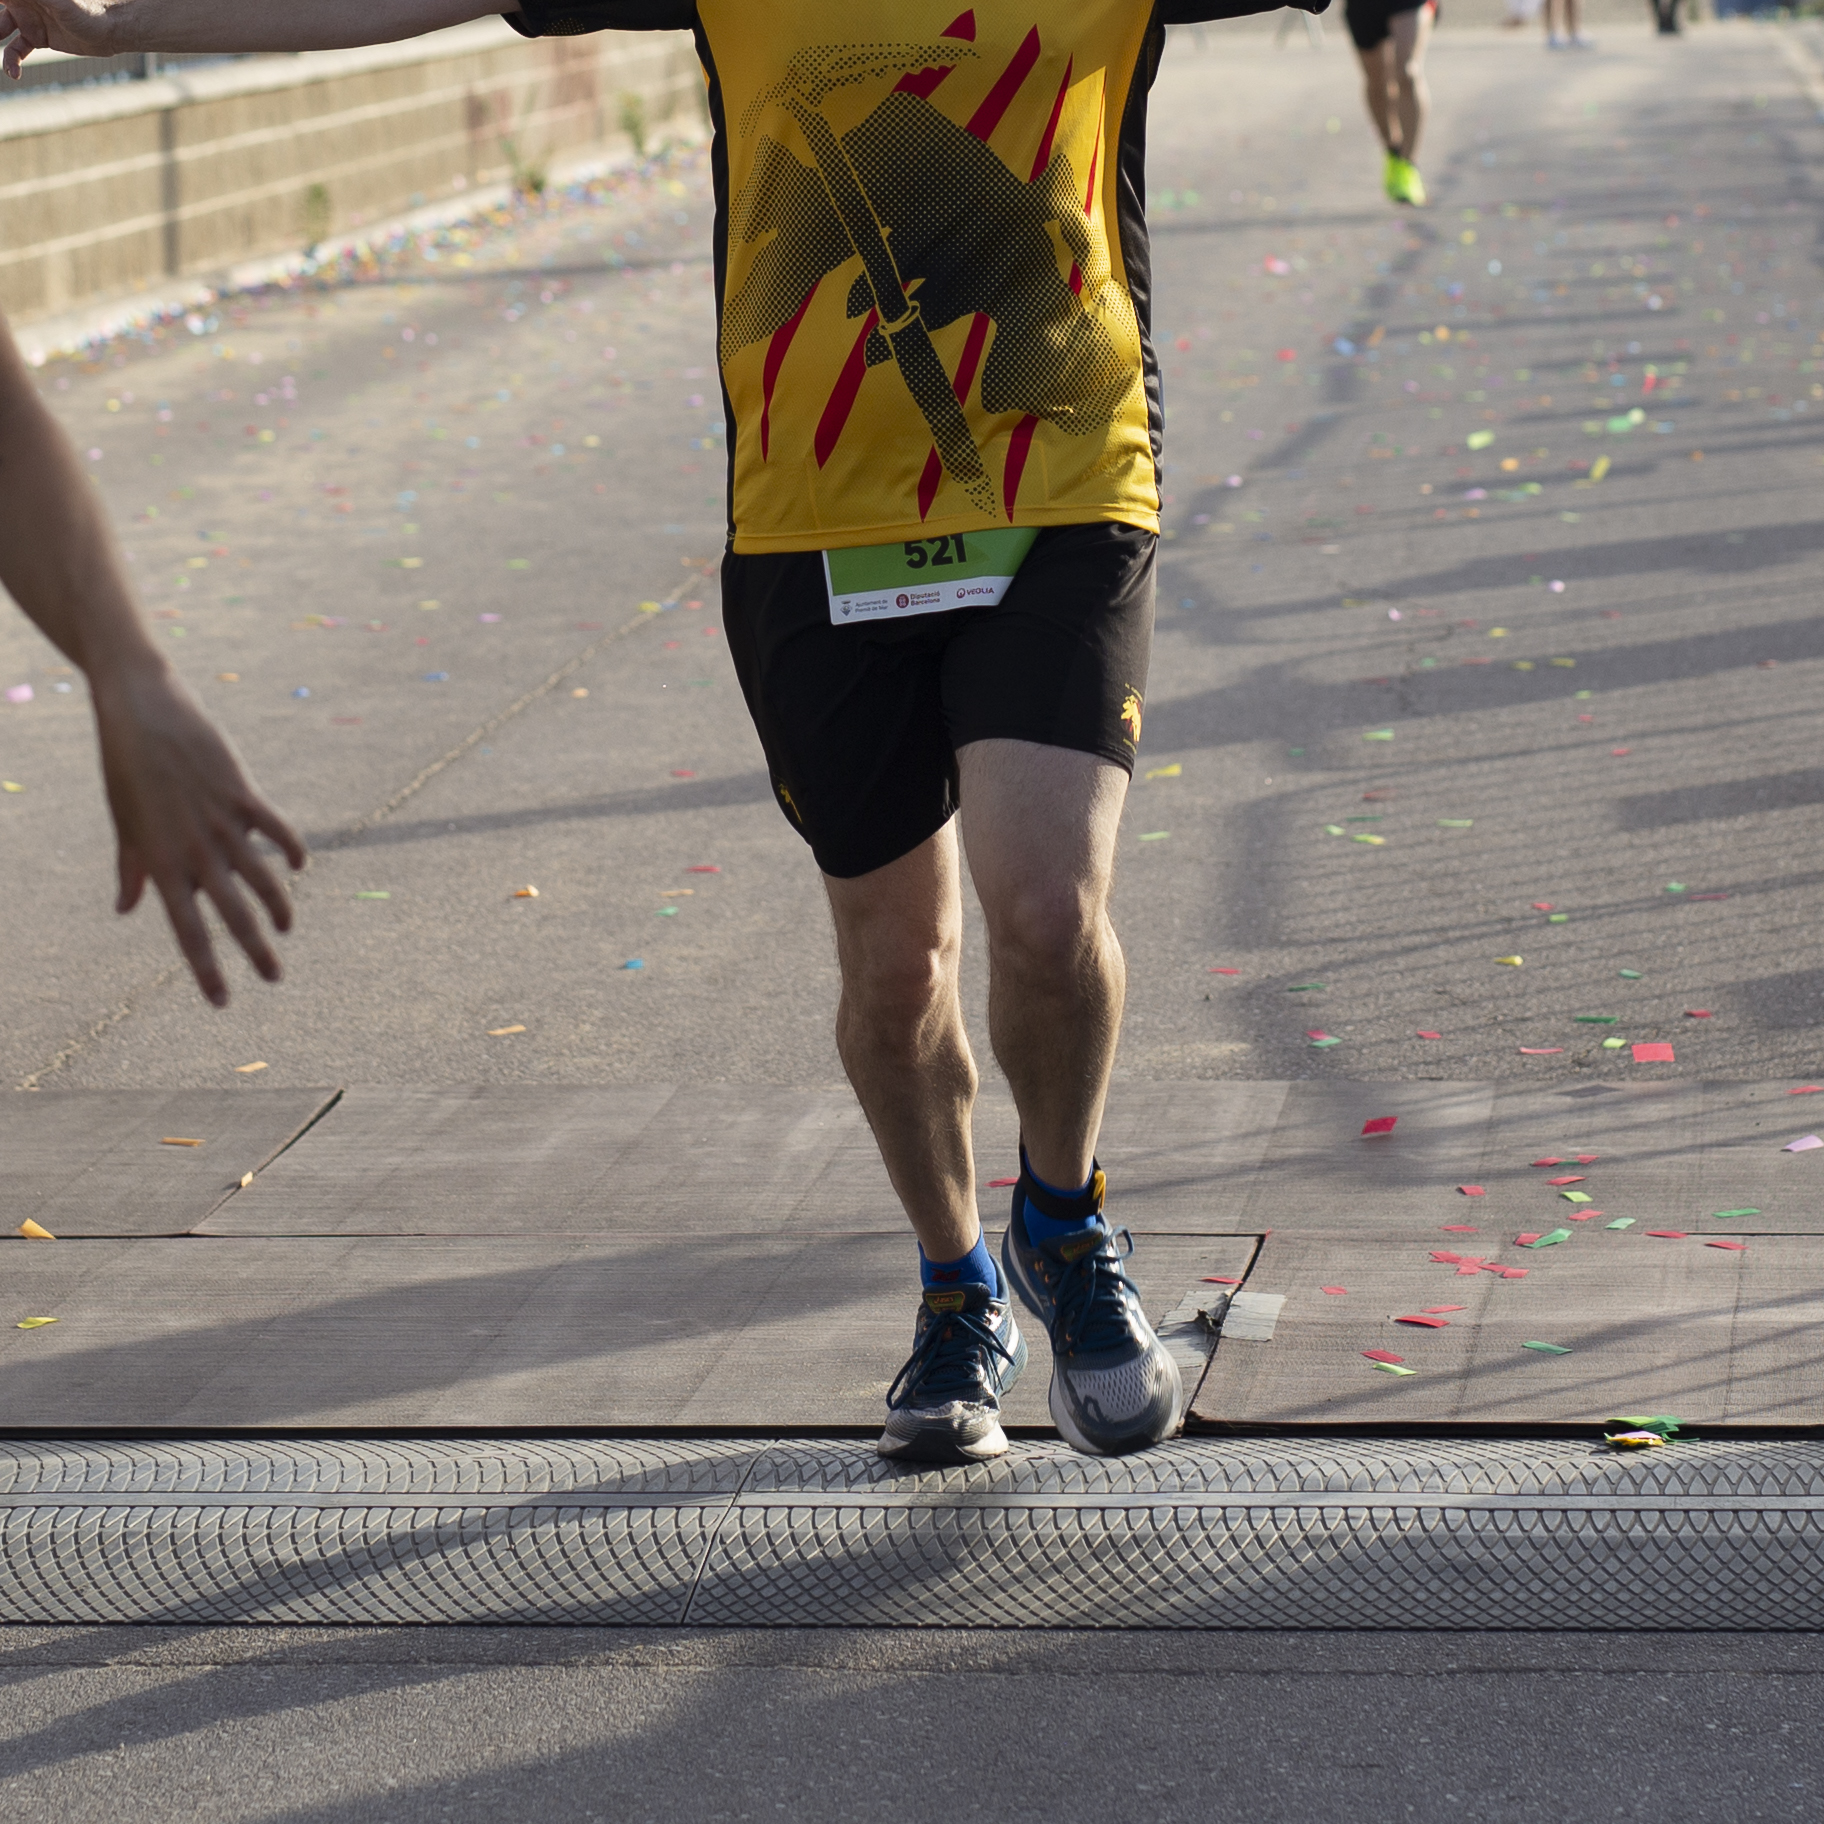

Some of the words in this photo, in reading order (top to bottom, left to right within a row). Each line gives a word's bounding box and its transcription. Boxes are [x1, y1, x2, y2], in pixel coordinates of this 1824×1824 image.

[904, 533, 967, 569] 521
[967, 587, 994, 595] VEOLIA
[910, 591, 940, 601] Diputació
[910, 598, 941, 607] Barcelona
